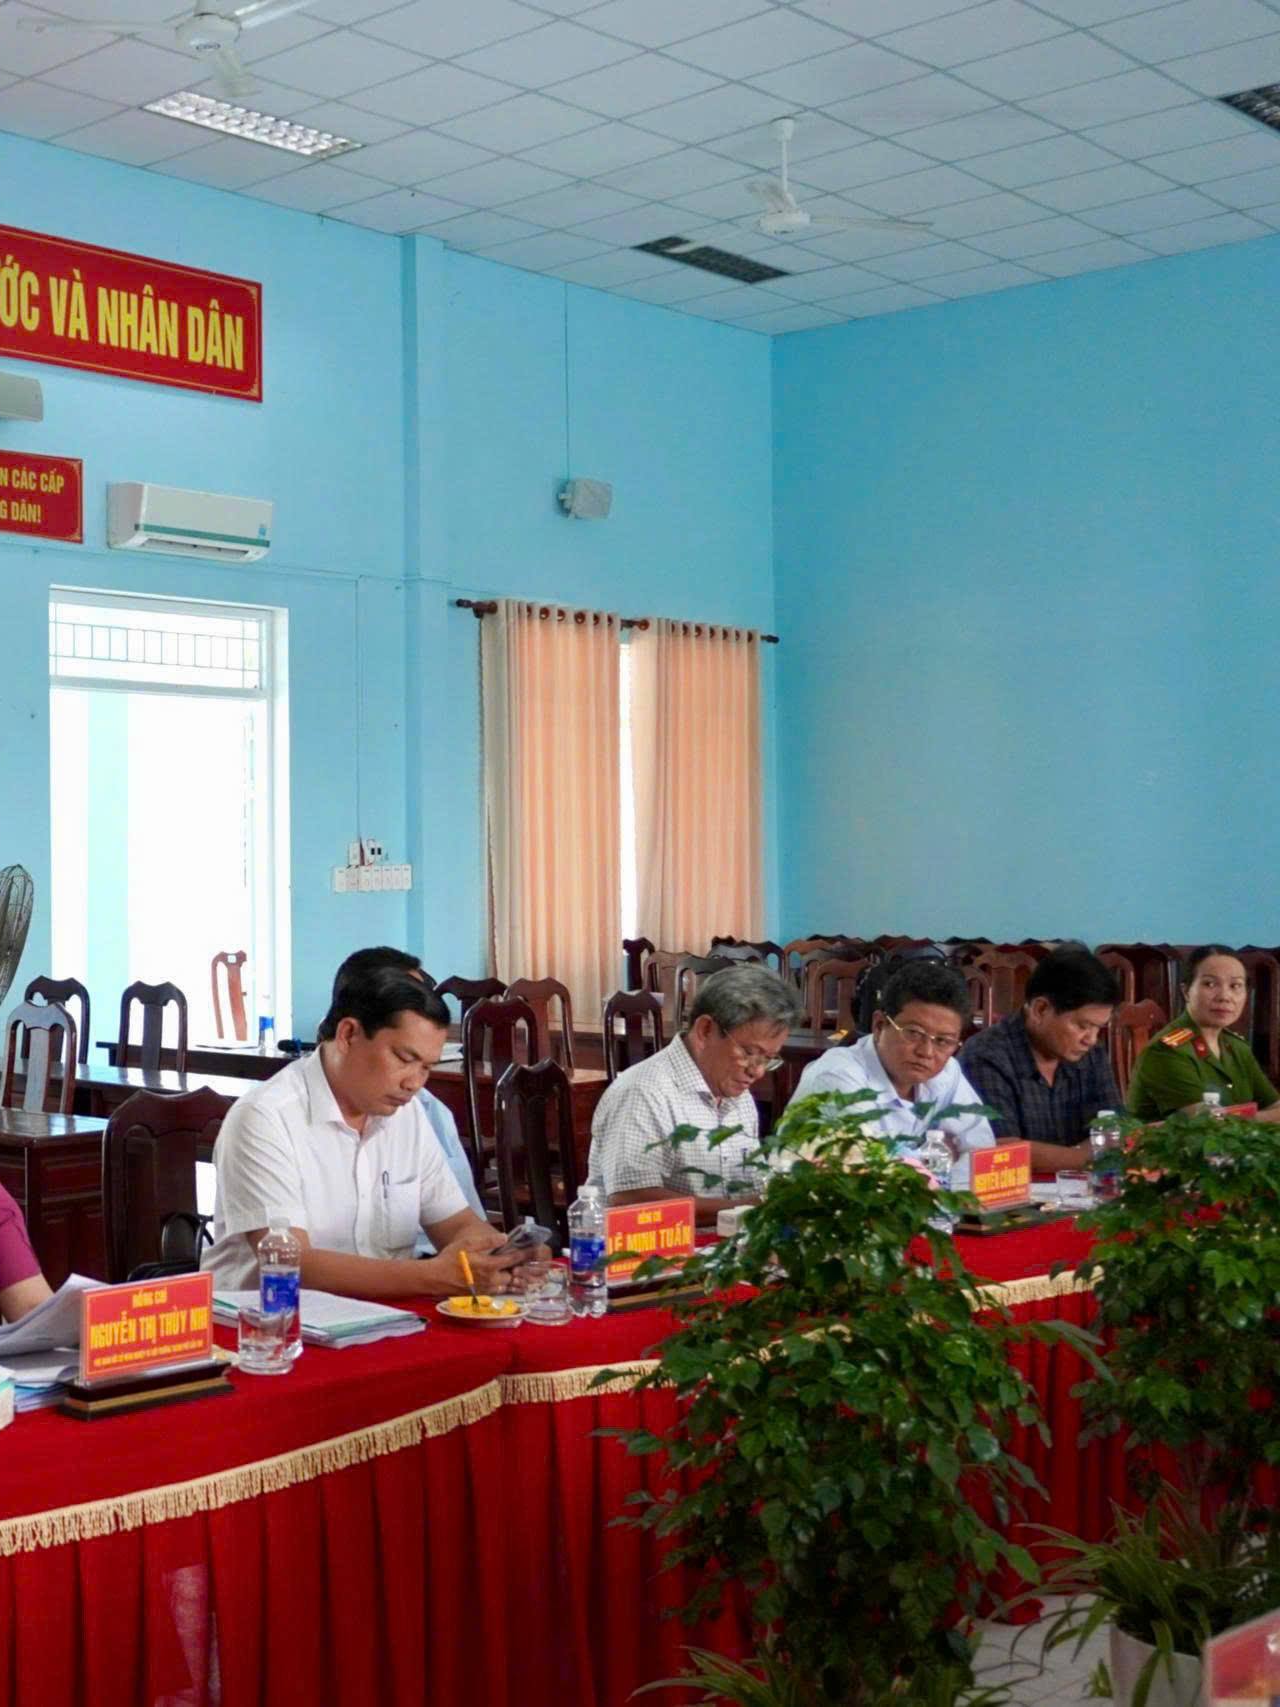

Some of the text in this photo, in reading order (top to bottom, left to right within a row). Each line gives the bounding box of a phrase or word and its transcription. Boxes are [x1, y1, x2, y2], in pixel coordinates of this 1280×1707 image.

[49, 268, 89, 342] VÀ
[97, 284, 180, 358] NHÂN
[187, 299, 244, 371] DÂN
[11, 468, 37, 491] CÁC
[39, 468, 65, 494] CẤP
[11, 499, 42, 524] DÂN!
